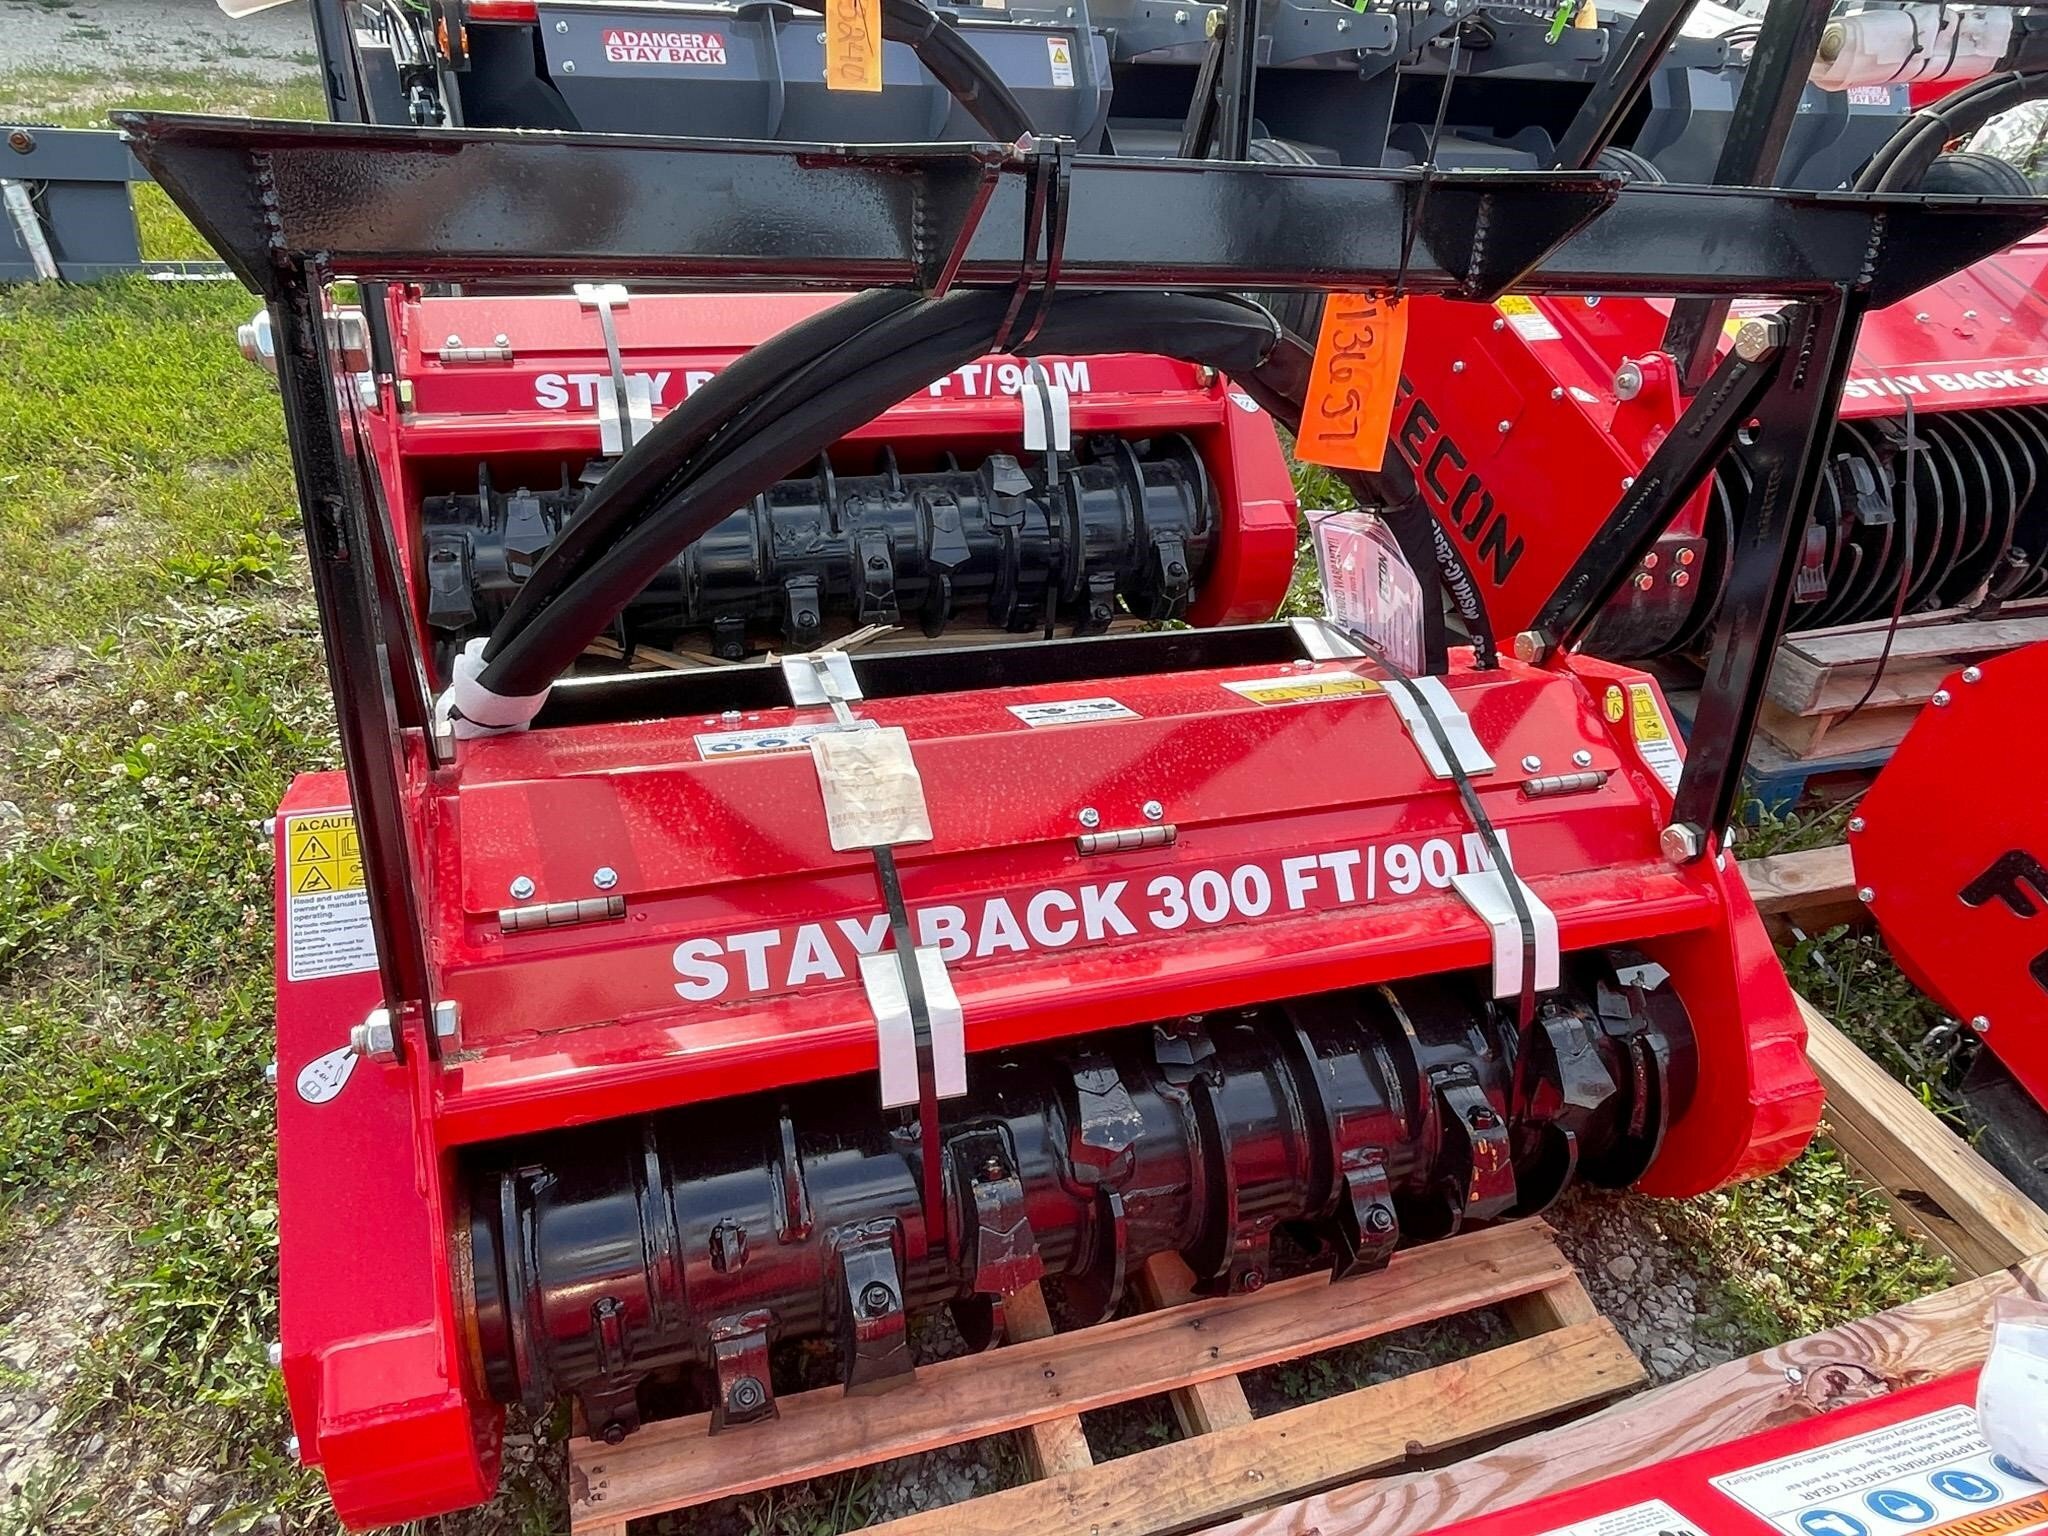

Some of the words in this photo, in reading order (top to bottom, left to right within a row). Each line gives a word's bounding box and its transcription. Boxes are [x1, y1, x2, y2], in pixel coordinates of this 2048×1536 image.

[624, 31, 705, 48] DANGER
[610, 47, 662, 60] STAY
[669, 49, 722, 63] BACK
[535, 372, 671, 409] STY
[1844, 375, 1930, 398] STAY
[1927, 368, 2034, 392] BACK
[1396, 373, 1525, 588] ECON
[310, 816, 355, 831] CAUTI
[294, 897, 314, 905] Read
[334, 891, 368, 901] underst
[294, 904, 325, 913] owner's
[328, 900, 357, 909] manual
[294, 912, 335, 921] operating.
[672, 914, 891, 1001] STAY
[917, 880, 1138, 962] BACK
[1147, 864, 1272, 930] 300
[1891, 1444, 1976, 1474] APPROPRIATE
[1842, 1469, 1891, 1490] SAFETY
[1799, 1484, 1840, 1500] GEAR
